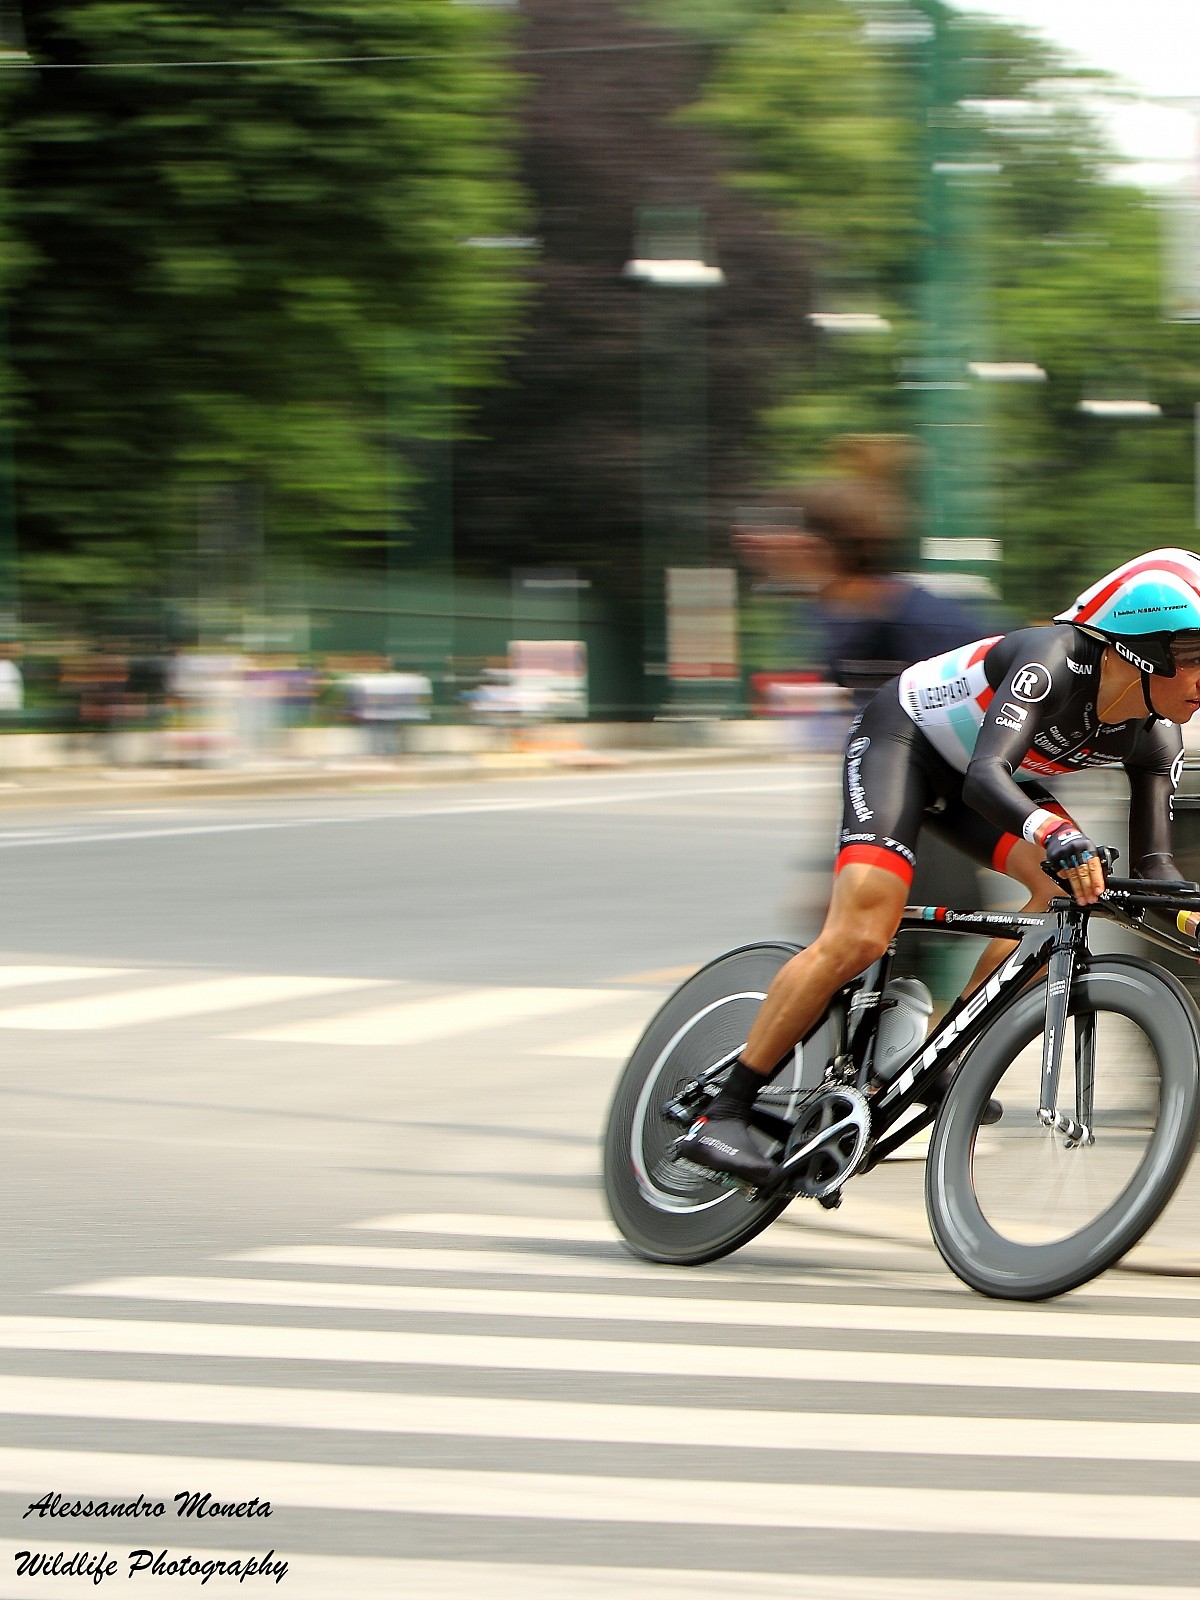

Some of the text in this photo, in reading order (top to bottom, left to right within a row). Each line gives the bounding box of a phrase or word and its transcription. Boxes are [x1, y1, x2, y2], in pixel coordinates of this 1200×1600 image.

[1115, 641, 1155, 674] GIRO
[986, 914, 1014, 924] NISSAN
[1017, 917, 1046, 926] TREK
[879, 951, 1024, 1105] TREK
